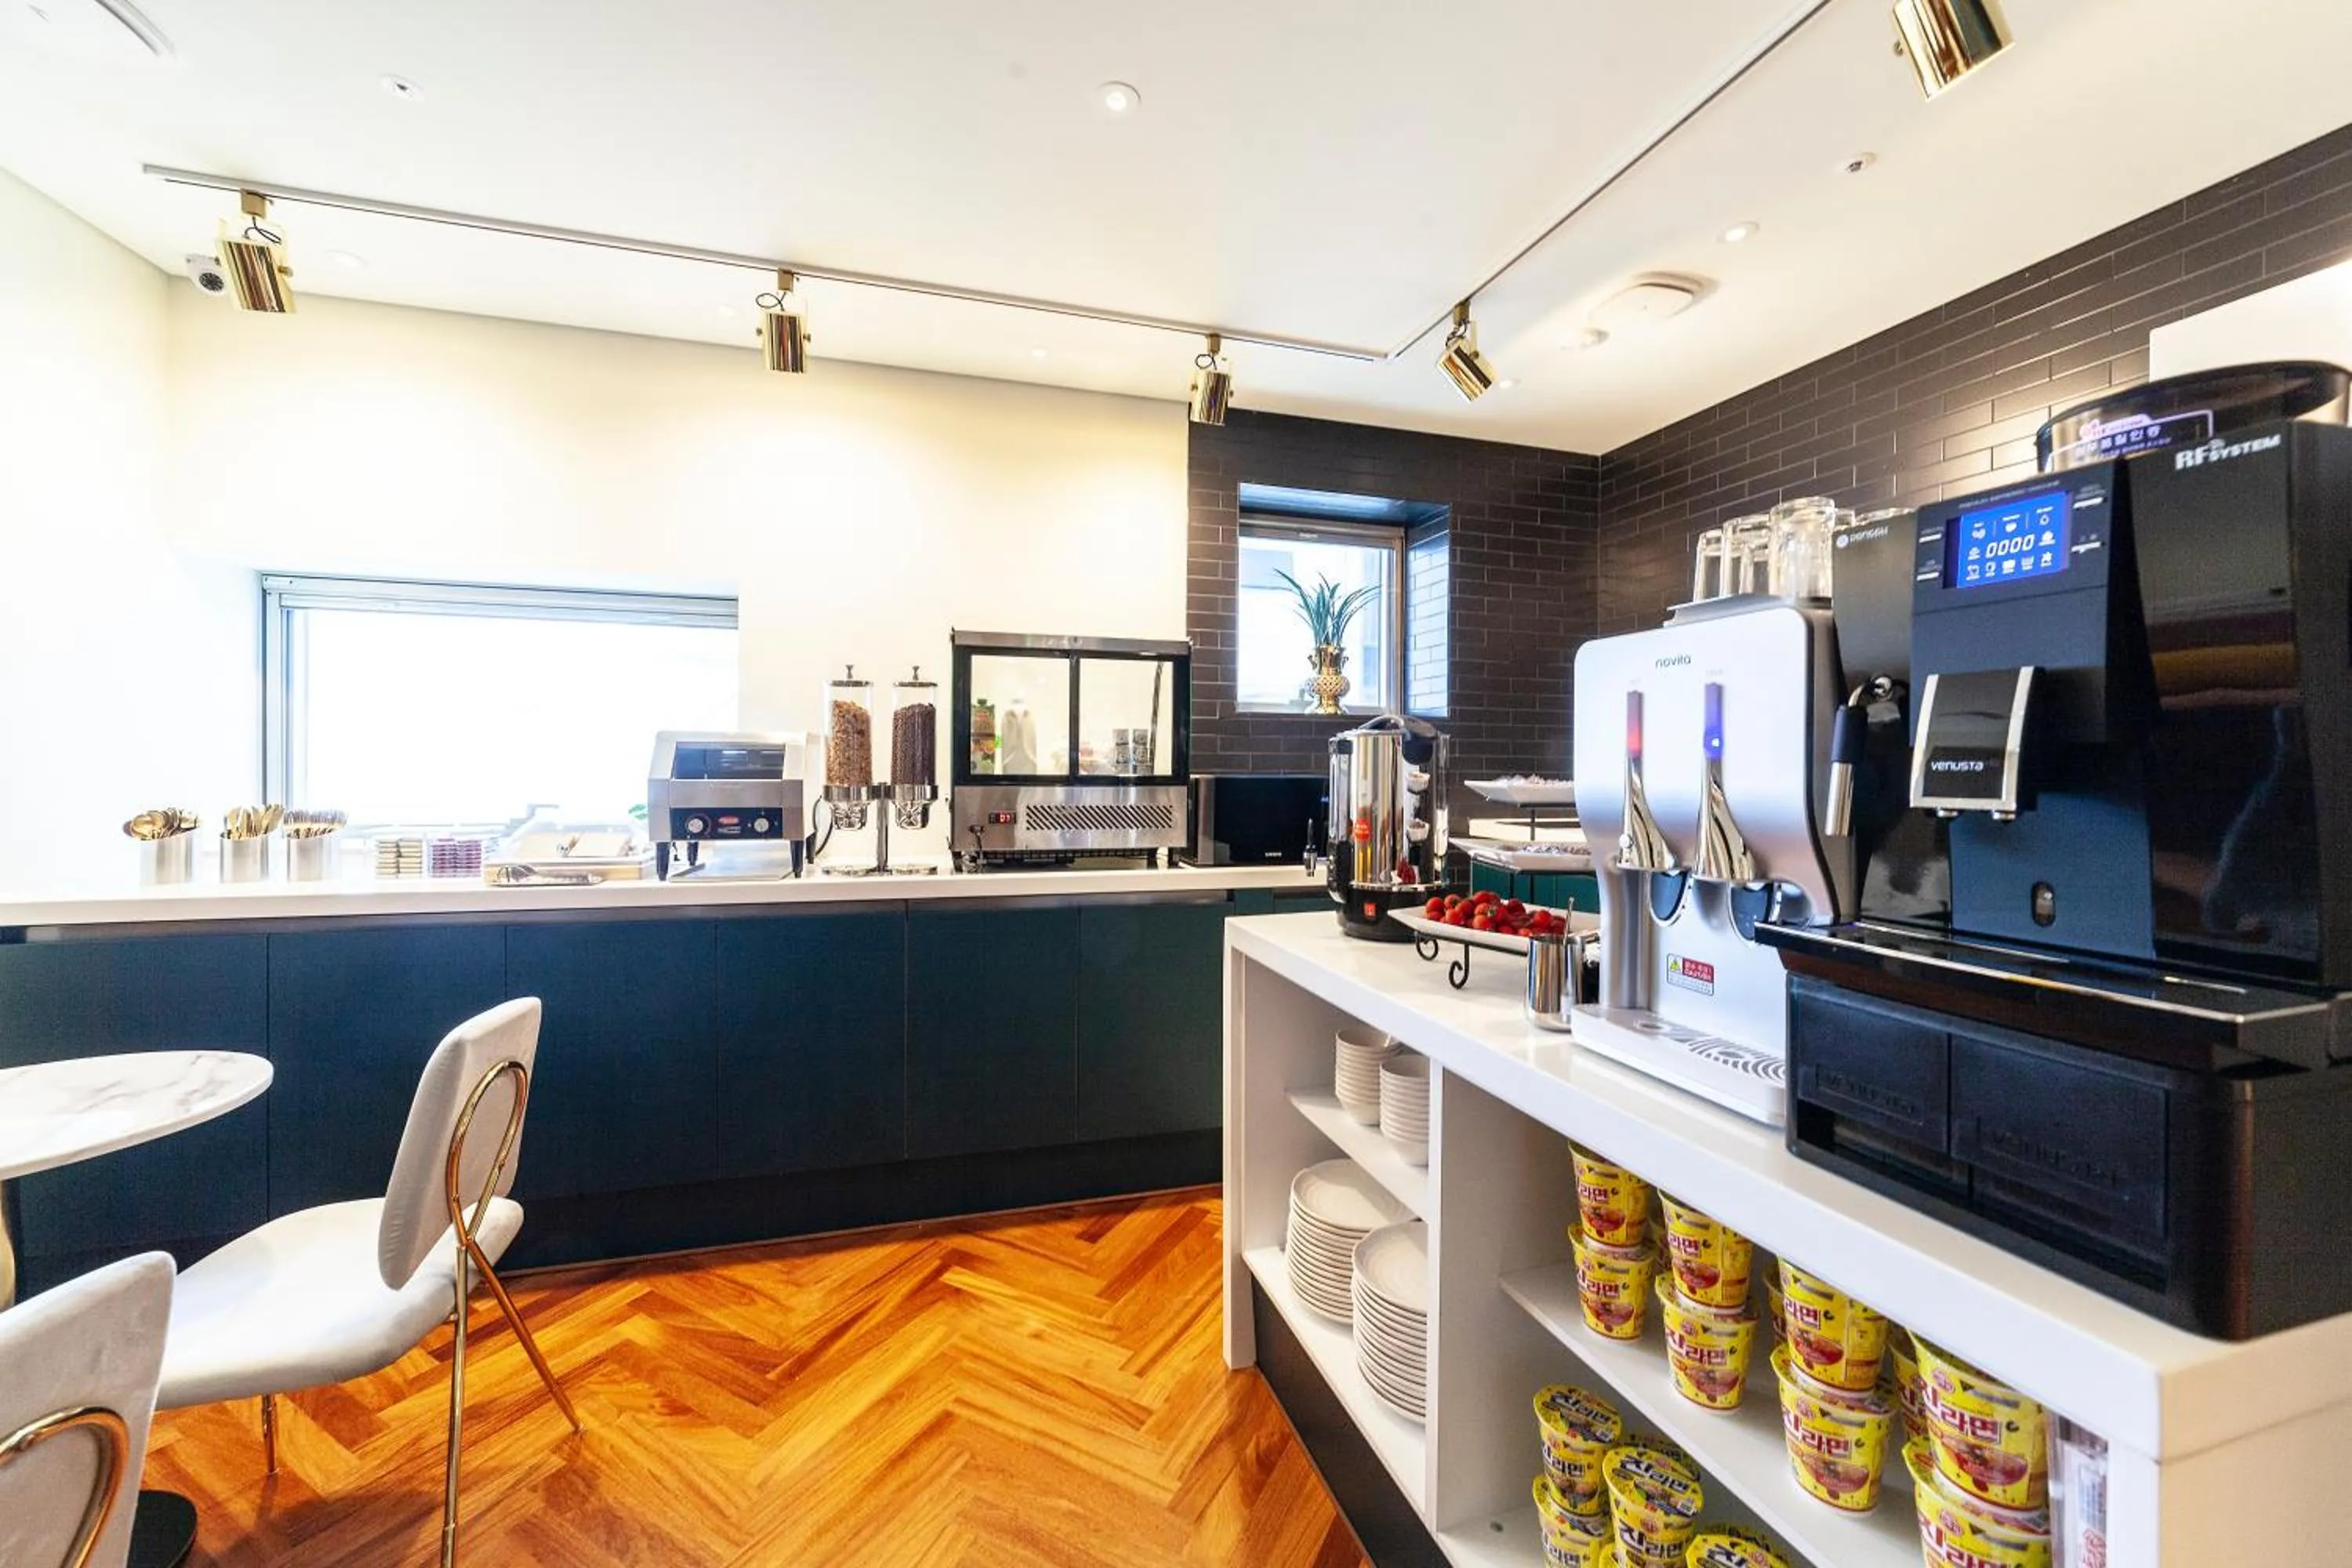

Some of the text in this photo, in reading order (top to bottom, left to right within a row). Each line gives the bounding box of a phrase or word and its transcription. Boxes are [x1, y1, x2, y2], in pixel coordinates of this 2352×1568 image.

[2175, 446, 2209, 470] RF
[2209, 434, 2281, 463] SYSTEM
[1984, 533, 2035, 559] 0000
[1655, 655, 1691, 668] novita
[1667, 1232, 1700, 1257] 라면
[1783, 1295, 1820, 1330] 라면
[1664, 1327, 1726, 1366] 진라면
[1921, 1377, 2002, 1445] 진라면
[1782, 1404, 1853, 1461] 진라면
